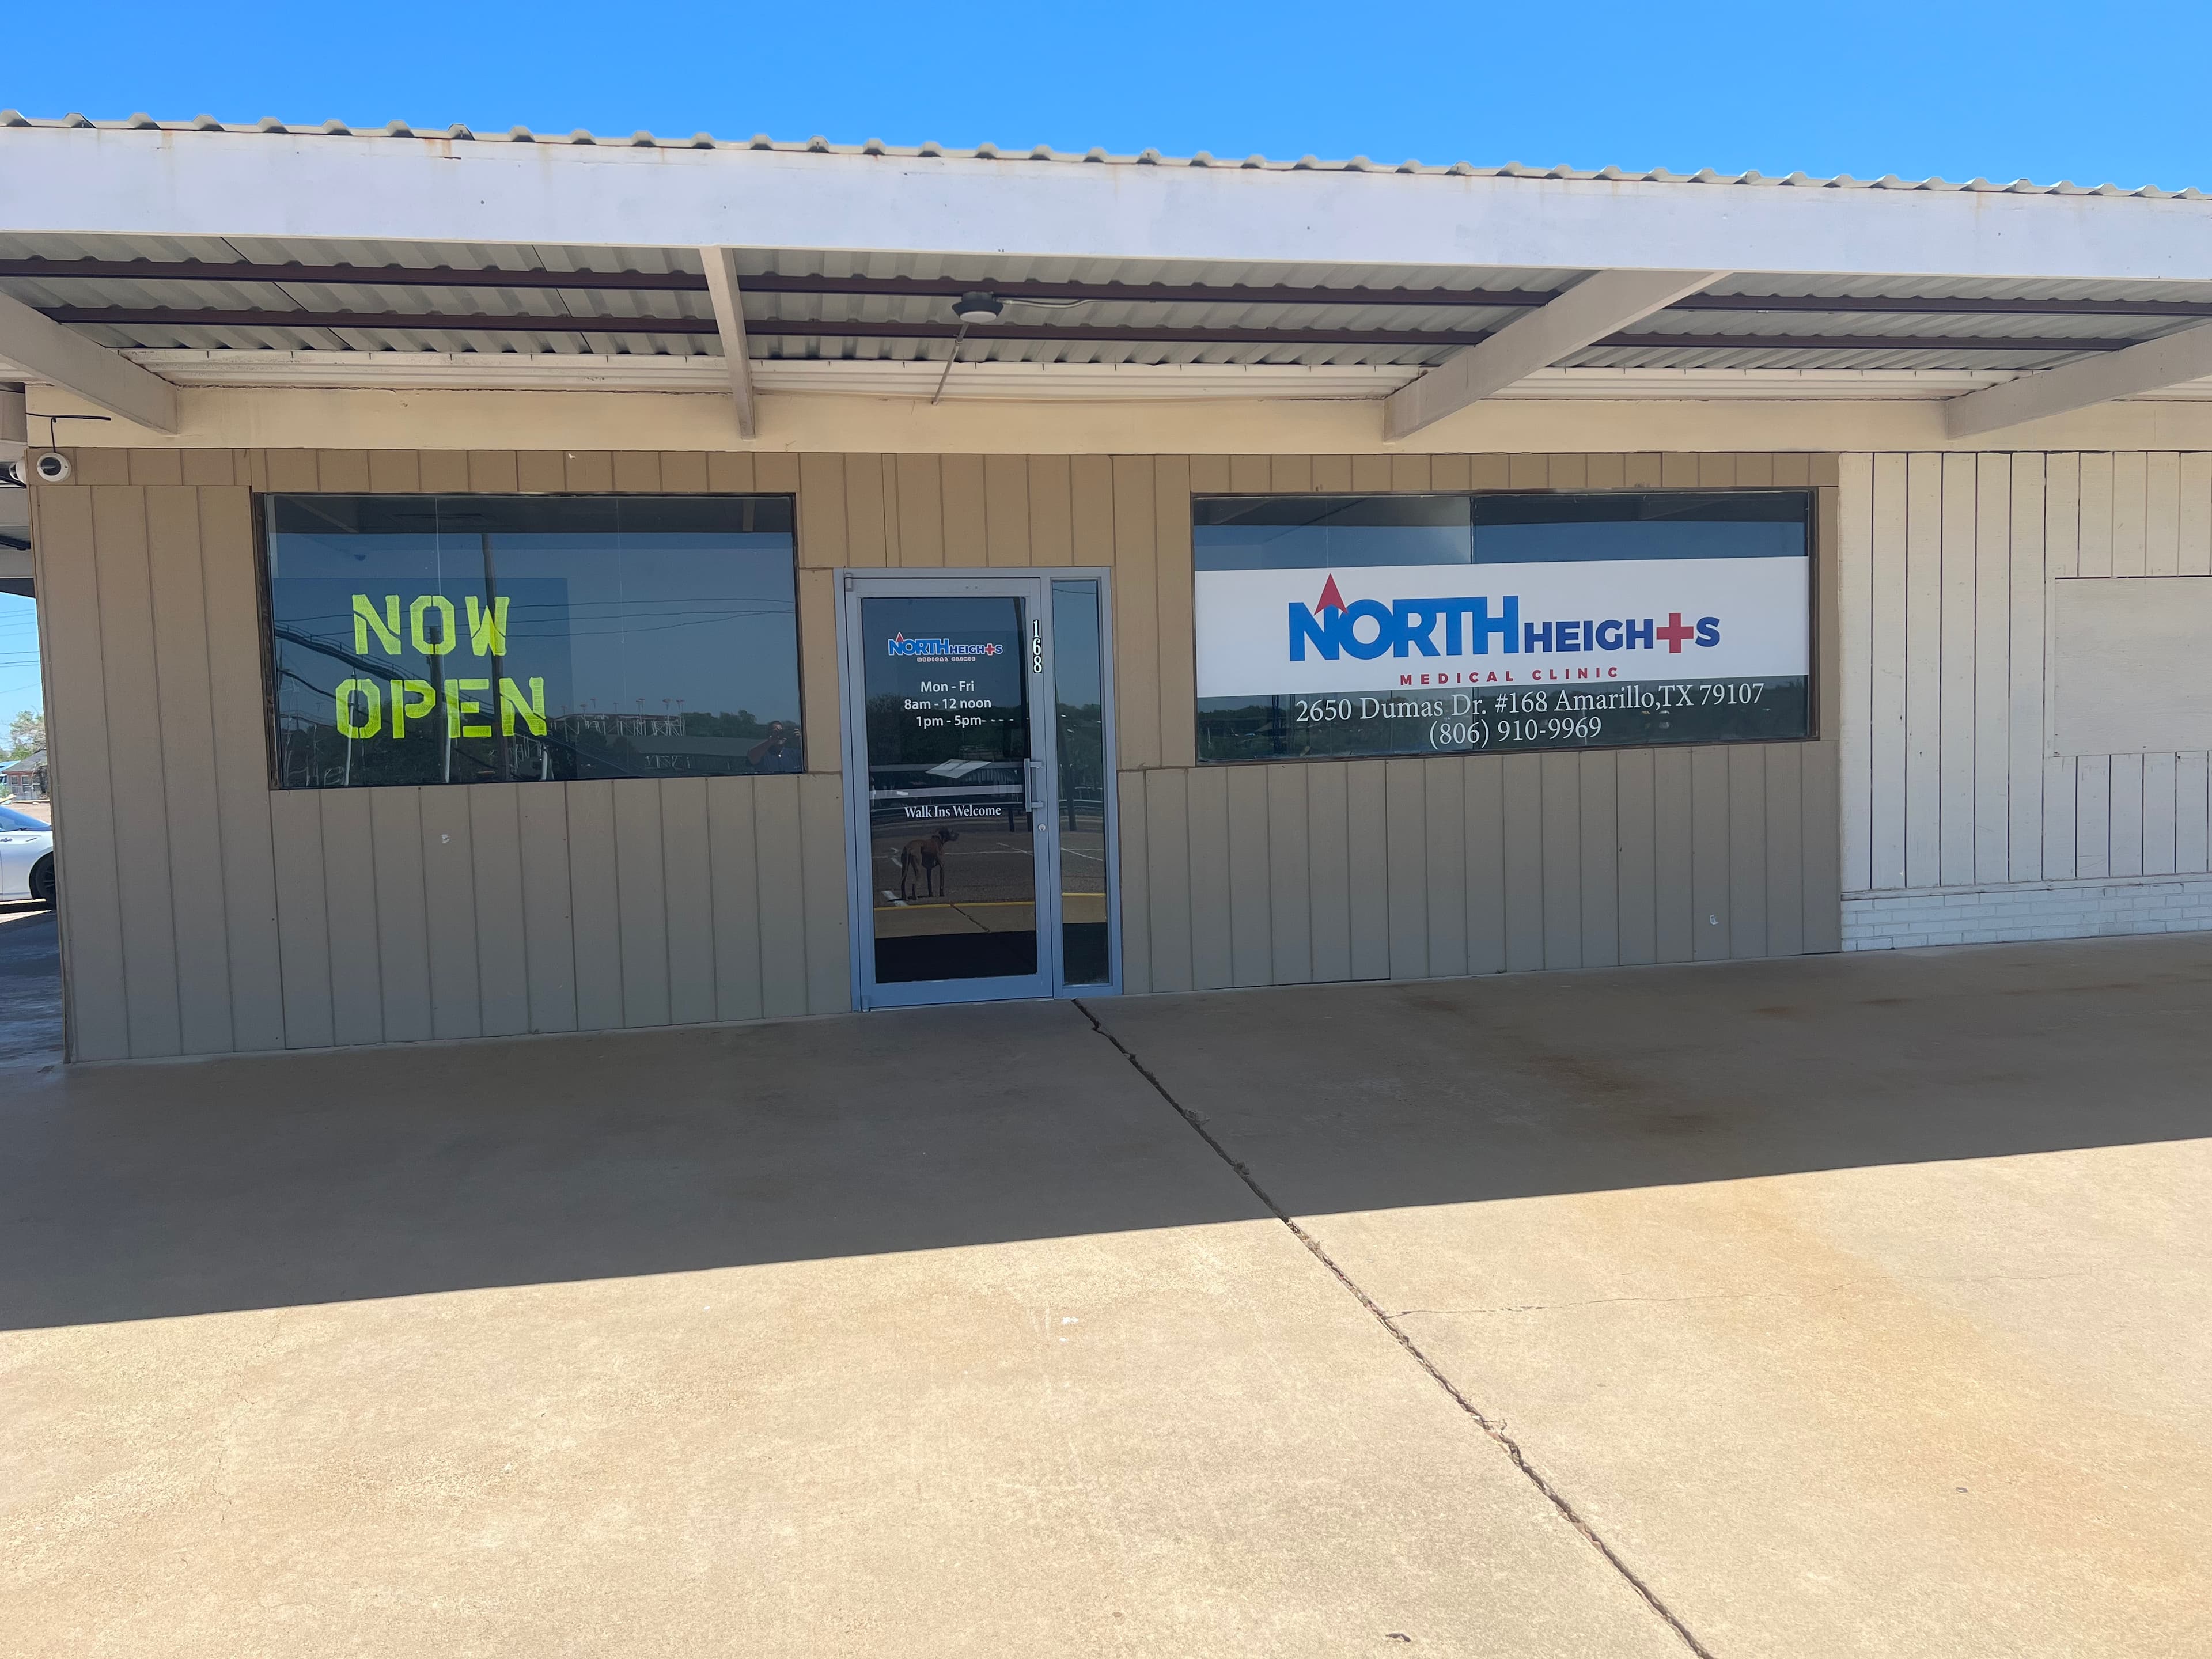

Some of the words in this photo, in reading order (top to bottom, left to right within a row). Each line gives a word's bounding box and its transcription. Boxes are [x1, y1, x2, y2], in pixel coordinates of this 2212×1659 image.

[352, 594, 510, 656] NOW
[1289, 595, 1519, 662] NORTH
[888, 638, 949, 656] NORTH
[1033, 619, 1042, 673] 168
[921, 681, 948, 692] Mon
[959, 680, 975, 692] Fri
[1400, 671, 1513, 685] MEDICAL
[1532, 666, 1619, 680] CLINIC
[336, 677, 547, 739] OPEN
[904, 699, 931, 710] 8am
[942, 698, 957, 709] 12
[960, 699, 991, 709] noon
[1296, 698, 1352, 722] 2650
[1359, 696, 1443, 720] Dumas
[1452, 694, 1486, 716] Dr.
[1495, 691, 1548, 714] #168
[1700, 682, 1765, 705] 79107
[916, 715, 944, 729] 1pm
[955, 715, 982, 728] 5pm
[1429, 718, 1490, 750] (806)
[1497, 716, 1602, 742] 910-9969
[904, 805, 932, 818] Walk
[934, 806, 950, 817] Ins
[952, 804, 1001, 817] Welcome
